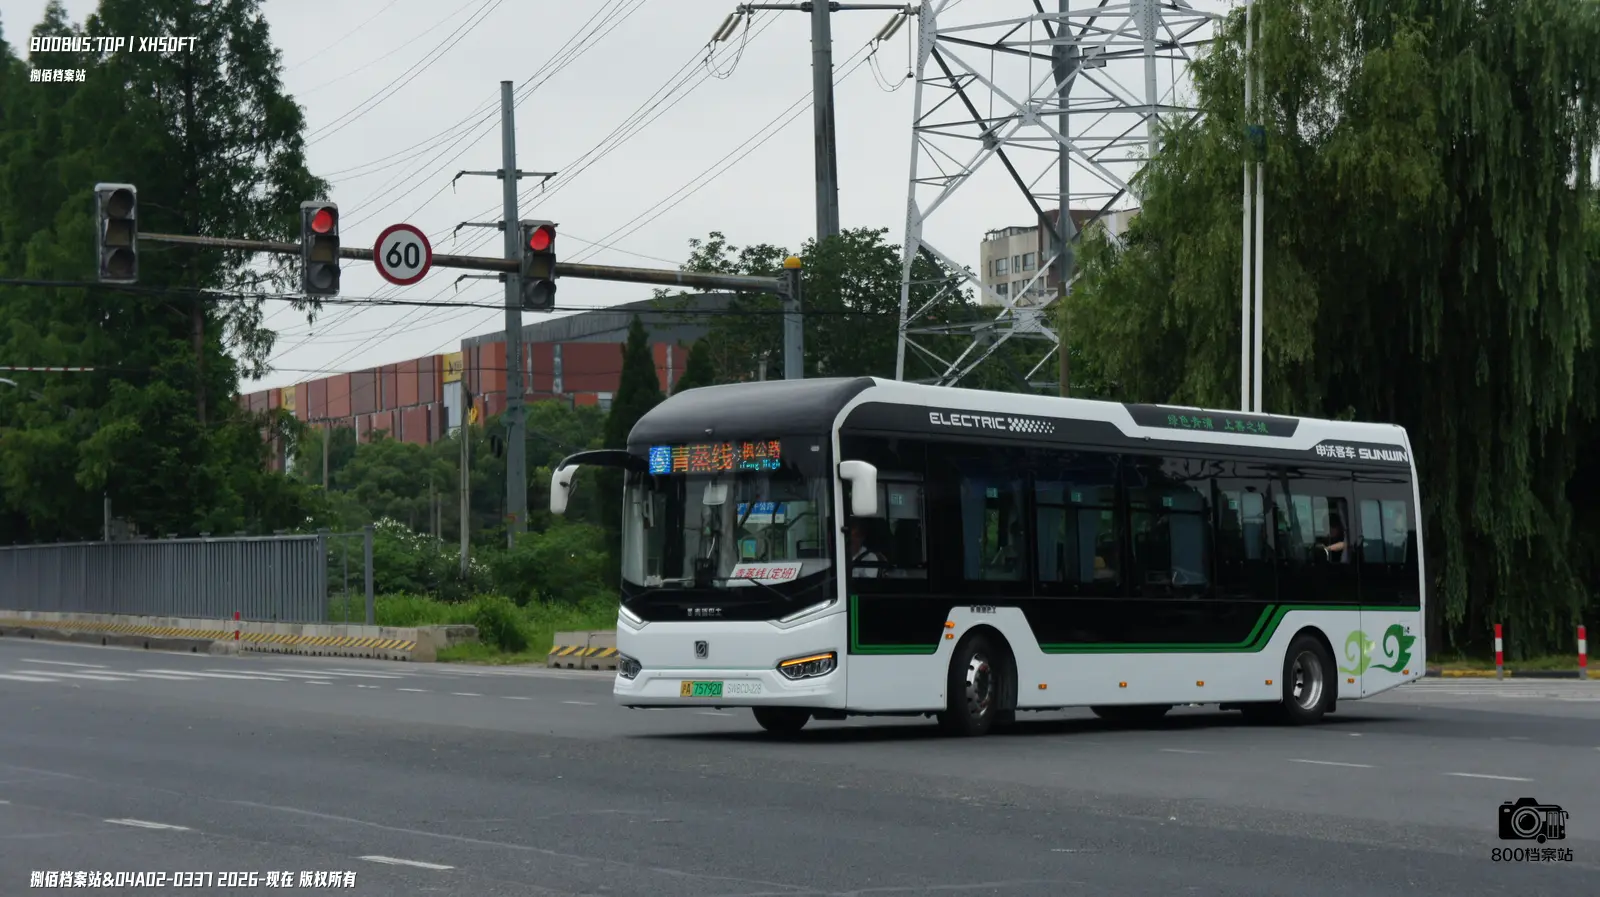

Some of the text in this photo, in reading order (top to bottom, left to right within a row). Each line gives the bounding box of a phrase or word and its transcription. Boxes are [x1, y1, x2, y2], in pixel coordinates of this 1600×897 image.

[386, 241, 420, 269] 60
[929, 412, 1006, 430] ELECTRIC
[671, 440, 780, 473] 青蒸线 枫公路
[1315, 444, 1409, 463] 申沃客车 SUNWIN
